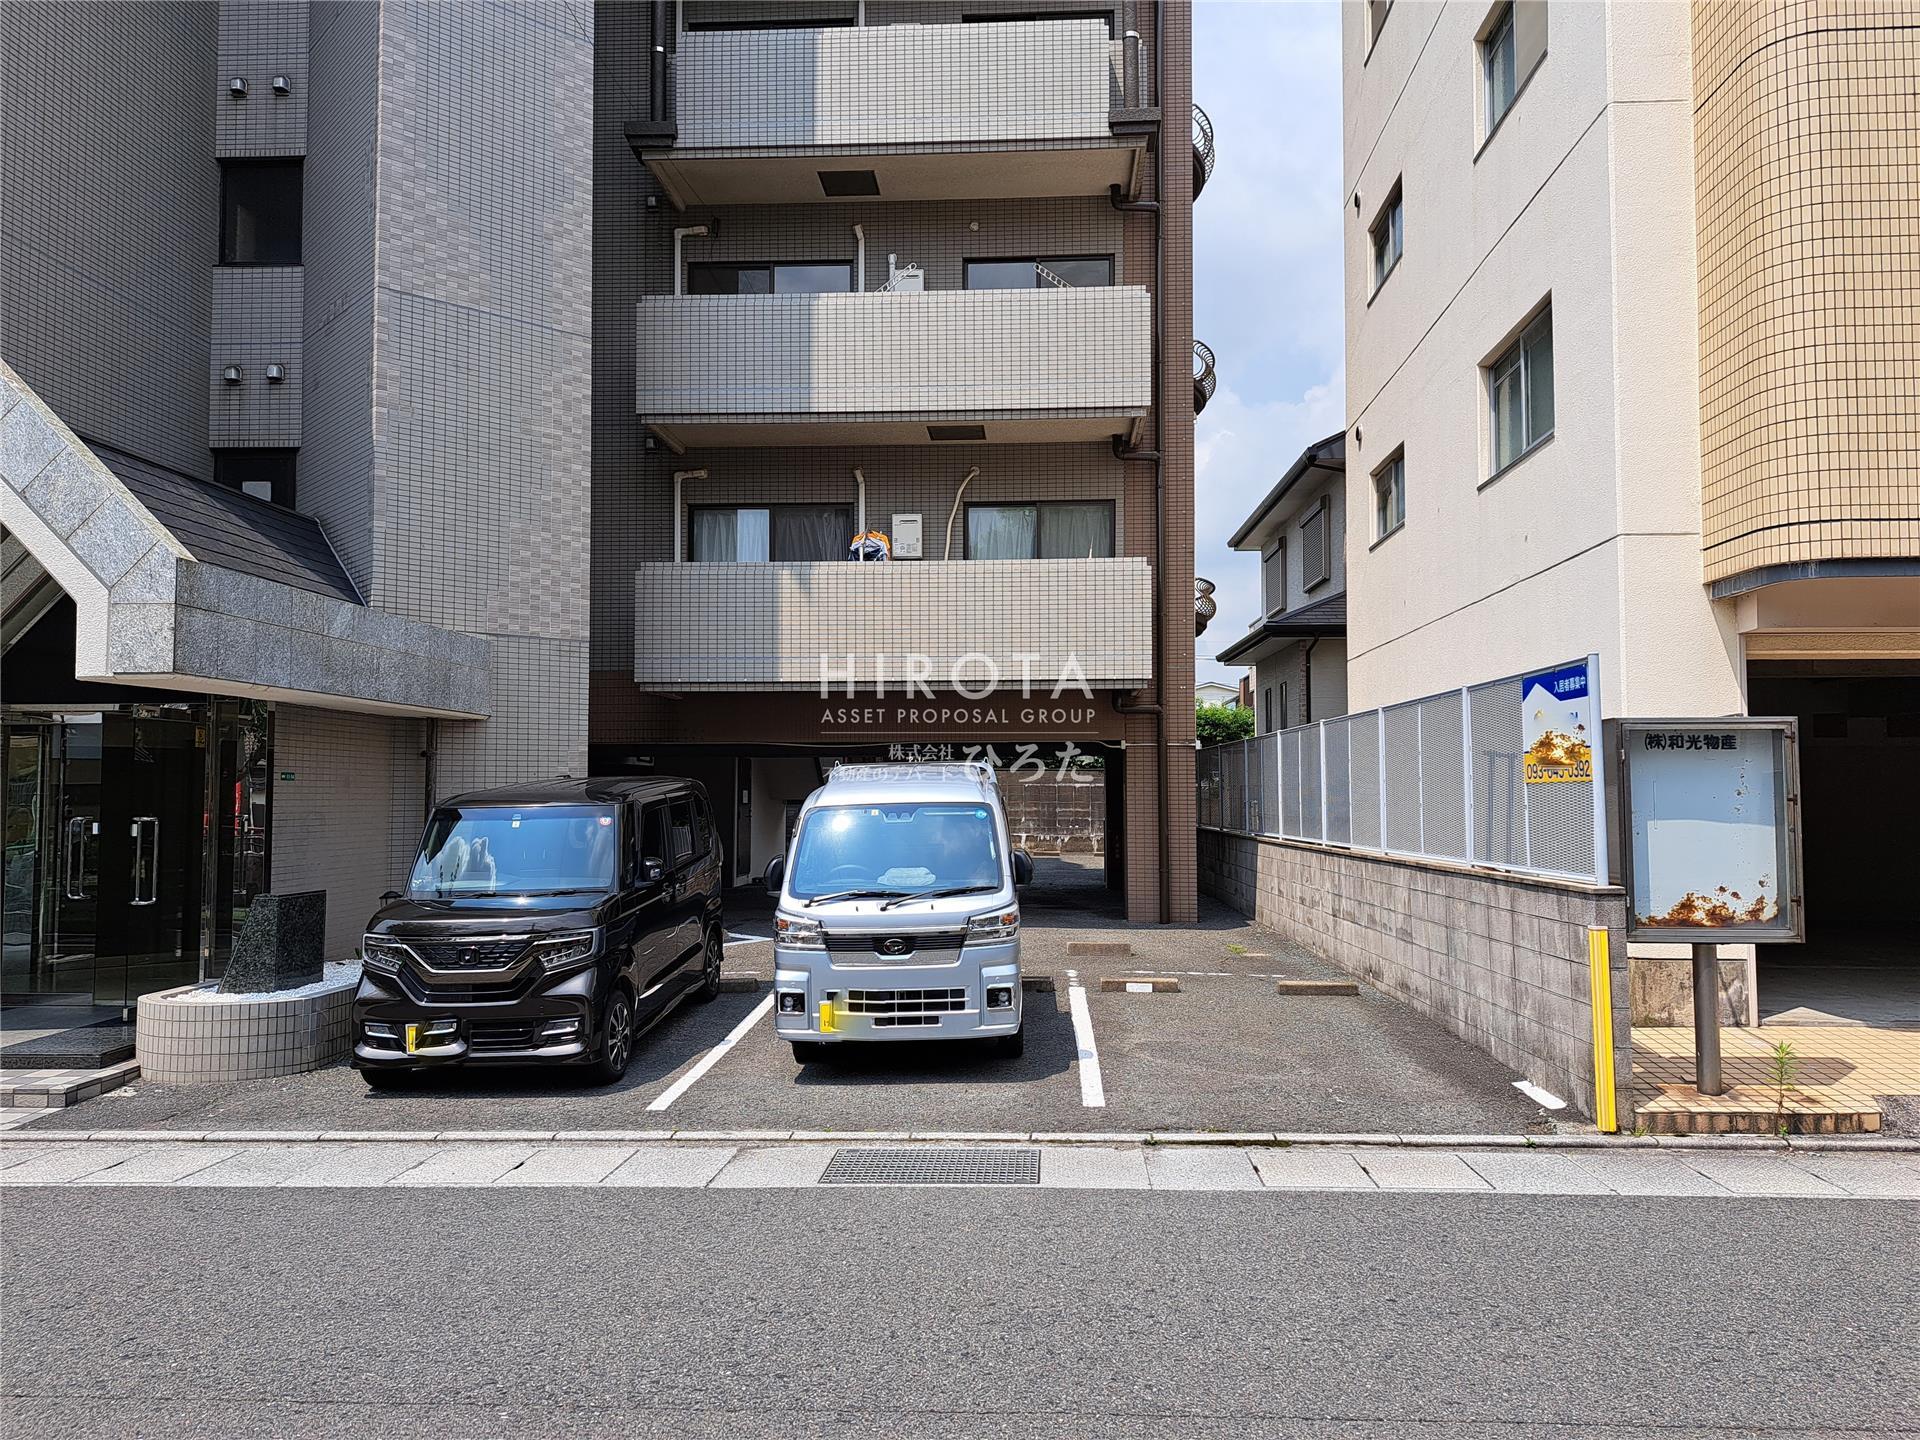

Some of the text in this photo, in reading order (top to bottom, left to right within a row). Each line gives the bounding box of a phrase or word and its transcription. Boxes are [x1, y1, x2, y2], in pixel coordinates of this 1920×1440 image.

[1553, 675, 1586, 694] 入居者募集中
[1644, 732, 1738, 751] (株)和光物産
